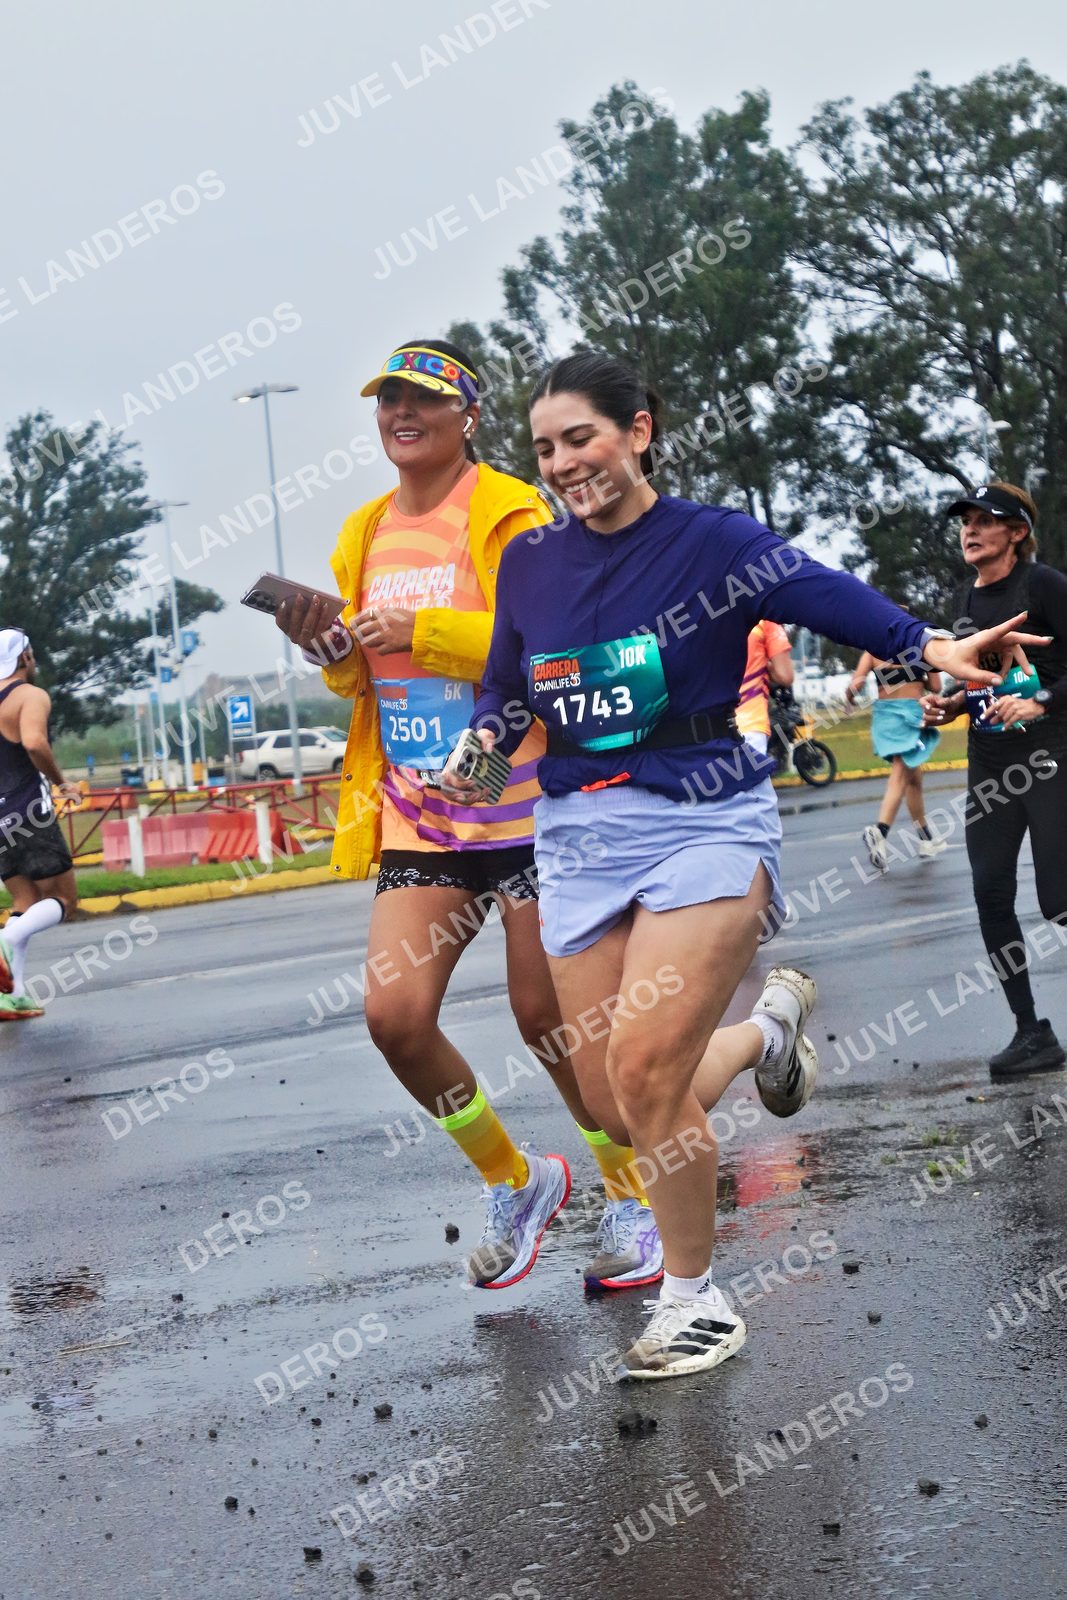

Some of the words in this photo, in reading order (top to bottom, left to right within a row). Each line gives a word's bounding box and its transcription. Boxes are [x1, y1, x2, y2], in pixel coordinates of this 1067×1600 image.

[368, 563, 455, 602] CARRERA
[618, 644, 646, 669] 10K
[534, 658, 580, 681] CARRERA
[445, 683, 463, 700] 5K
[553, 685, 634, 725] 1743
[389, 716, 442, 742] 2501
